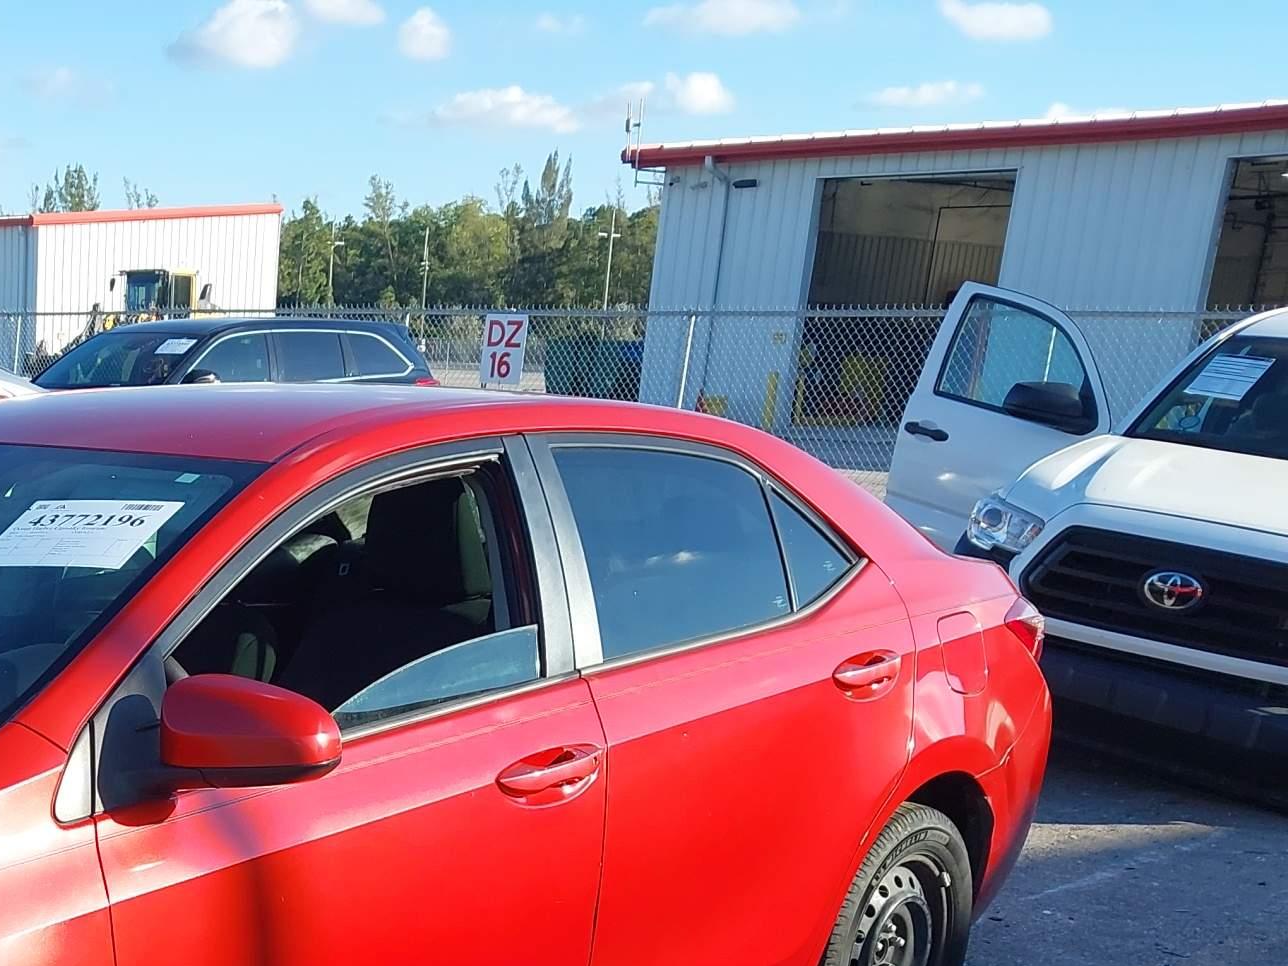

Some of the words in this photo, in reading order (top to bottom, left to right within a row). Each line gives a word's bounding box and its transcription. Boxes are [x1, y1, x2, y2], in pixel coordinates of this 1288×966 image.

[487, 319, 524, 348] DZ
[489, 351, 511, 378] 16
[28, 513, 151, 528] 43772196
